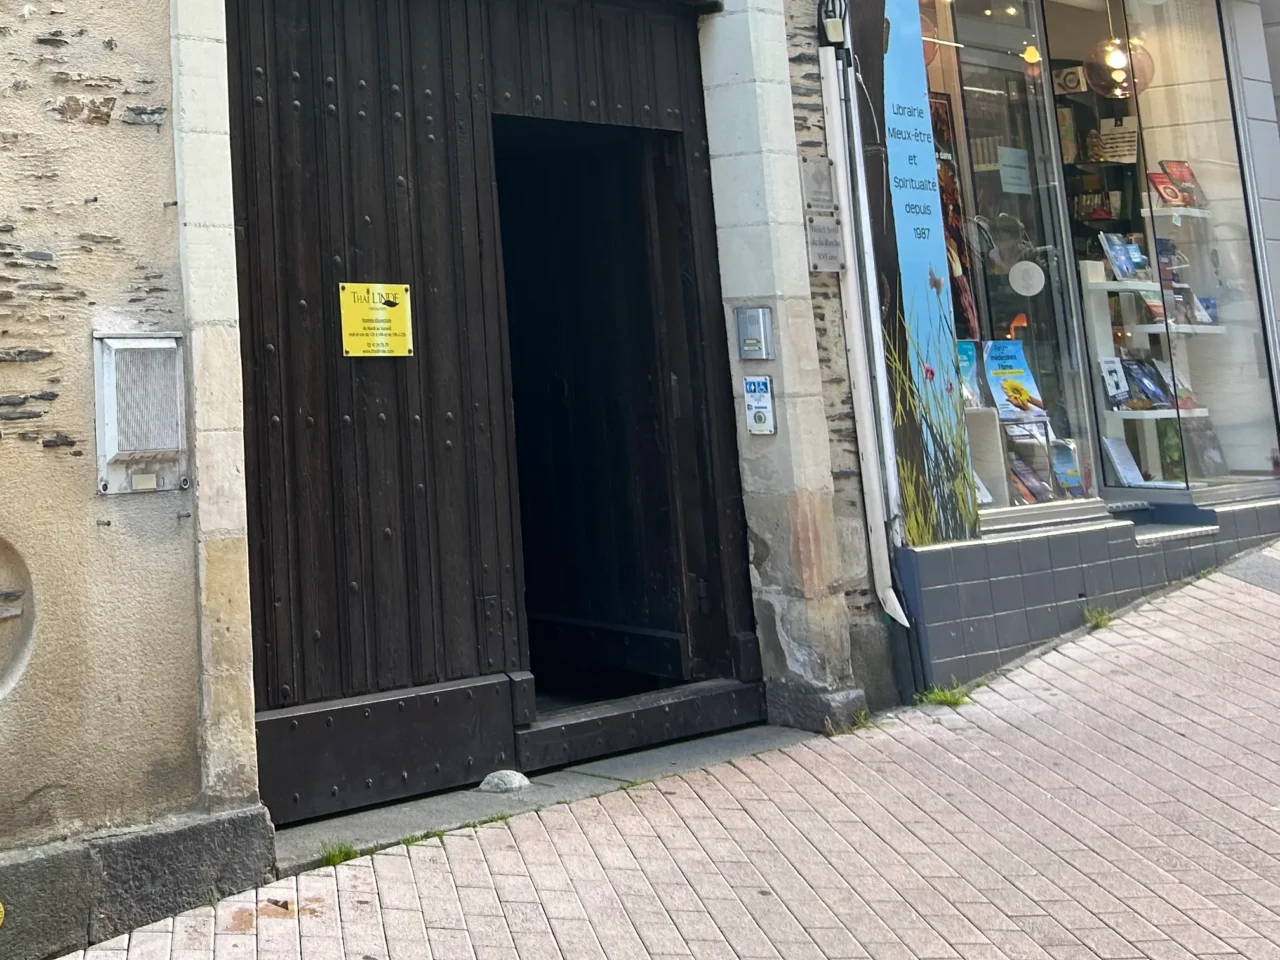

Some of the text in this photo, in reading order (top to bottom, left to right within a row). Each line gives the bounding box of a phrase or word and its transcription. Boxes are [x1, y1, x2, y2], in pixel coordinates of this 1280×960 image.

[891, 103, 924, 119] Librairie
[887, 127, 932, 144] Mieux-être
[908, 153, 918, 166] et
[893, 176, 937, 192] Spiritualité
[904, 202, 932, 217] depuis
[913, 227, 931, 240] 1987
